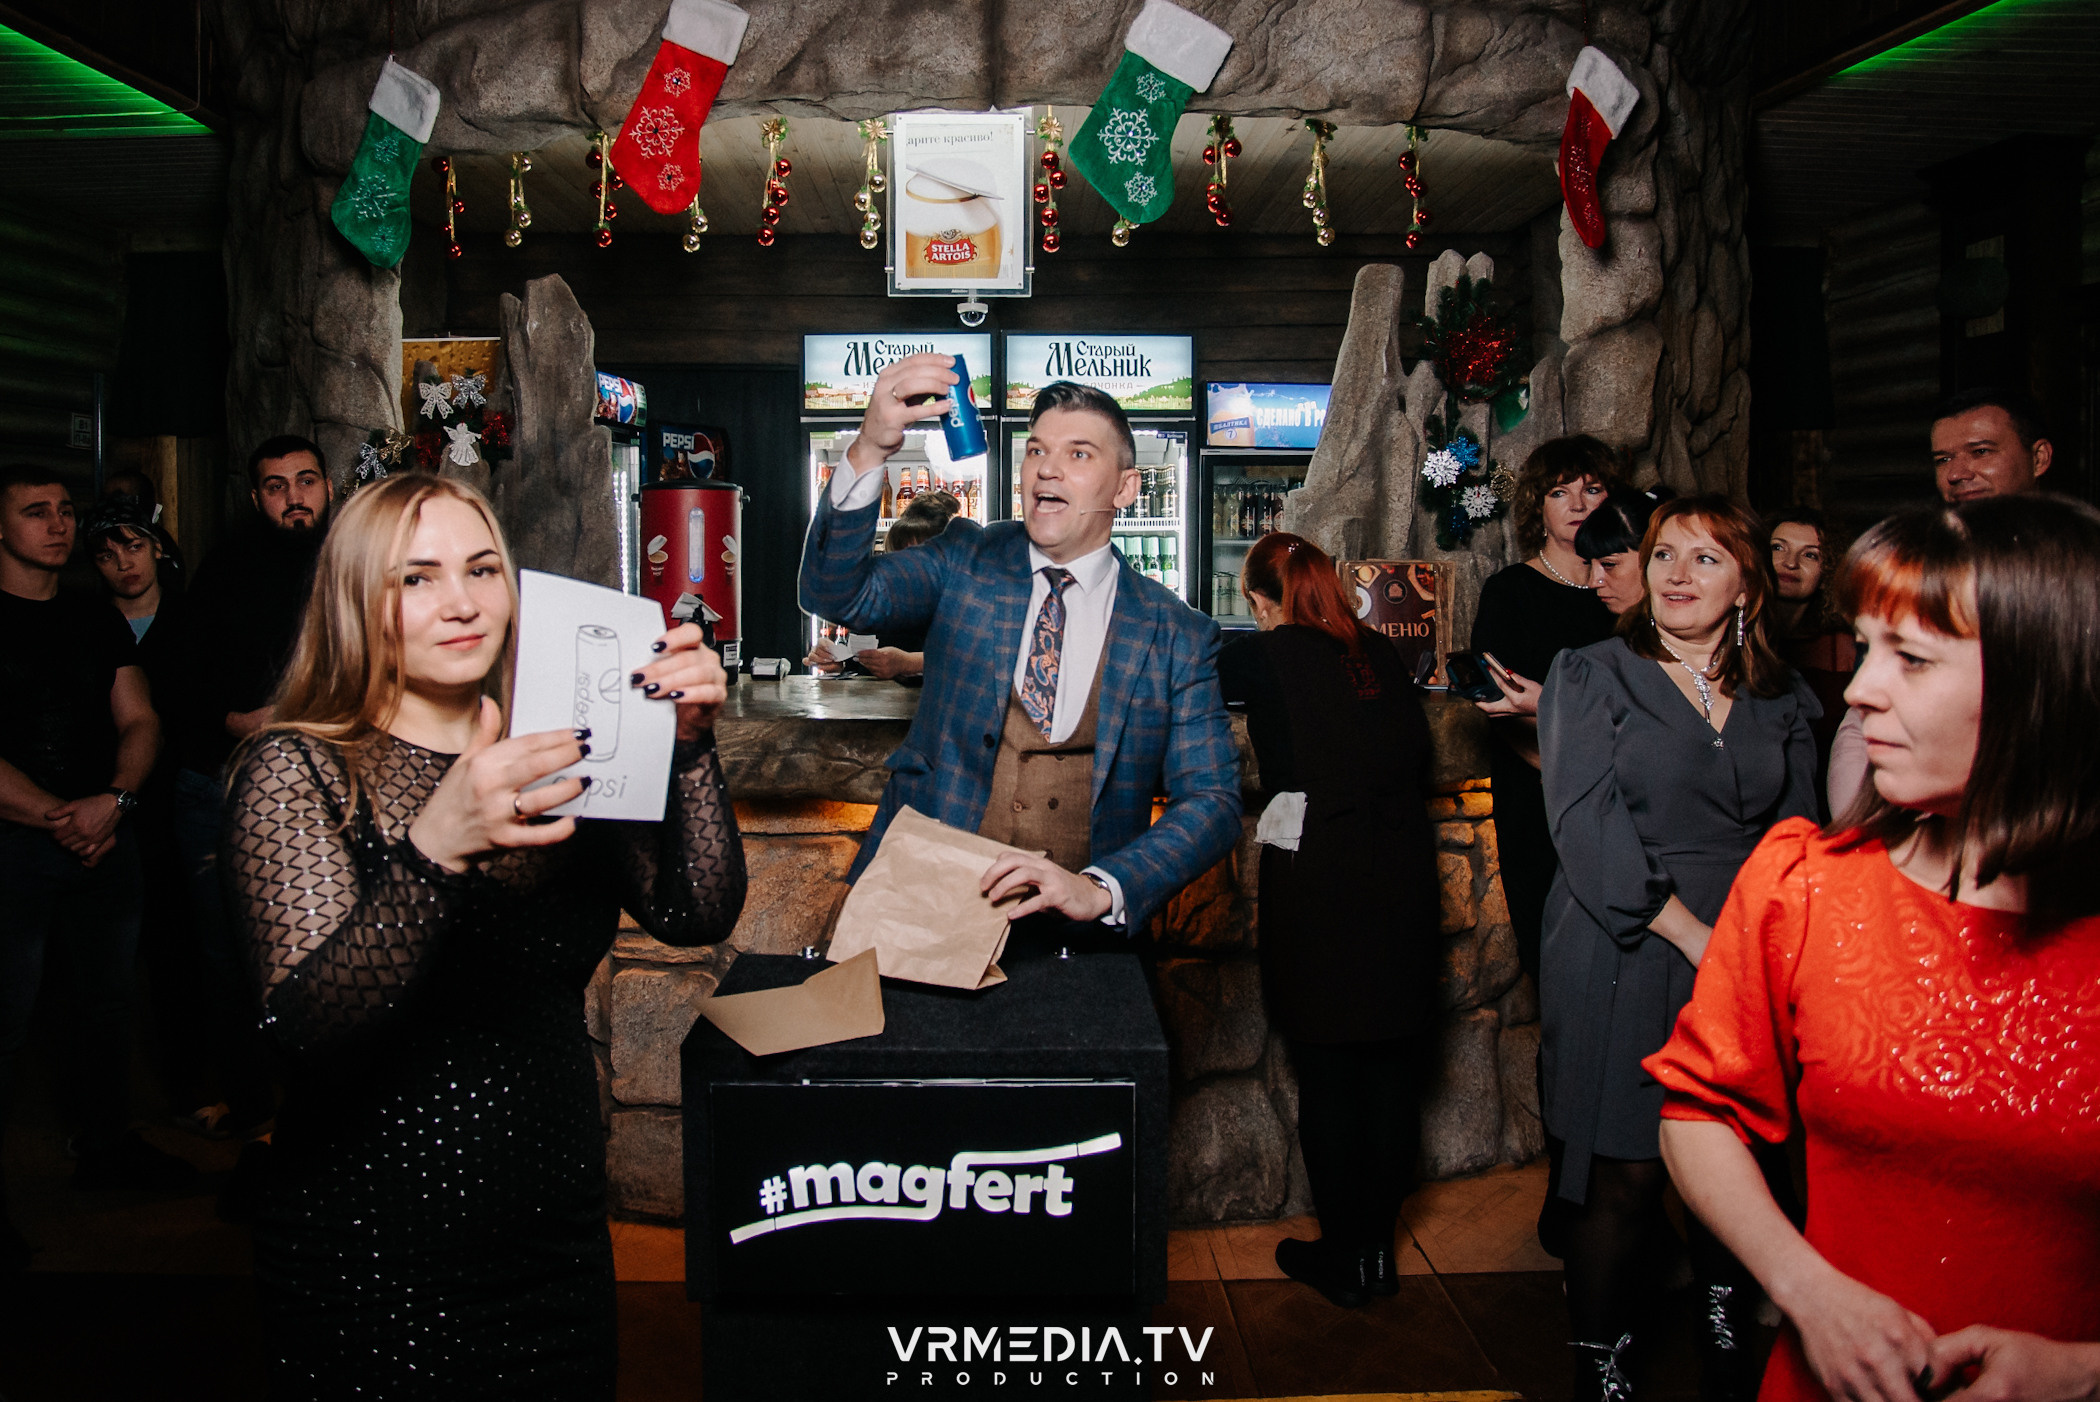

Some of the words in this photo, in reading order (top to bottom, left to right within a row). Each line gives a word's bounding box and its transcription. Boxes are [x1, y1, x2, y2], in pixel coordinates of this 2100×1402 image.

[906, 134, 941, 147] арите
[944, 131, 993, 146] красиво!
[931, 242, 970, 253] STELLA
[931, 251, 971, 261] ARTOIS
[875, 339, 934, 358] Старый
[1077, 340, 1136, 359] Старый
[1045, 342, 1152, 377] Мельник
[598, 373, 623, 394] PEPSI
[662, 432, 695, 451] PEPSI
